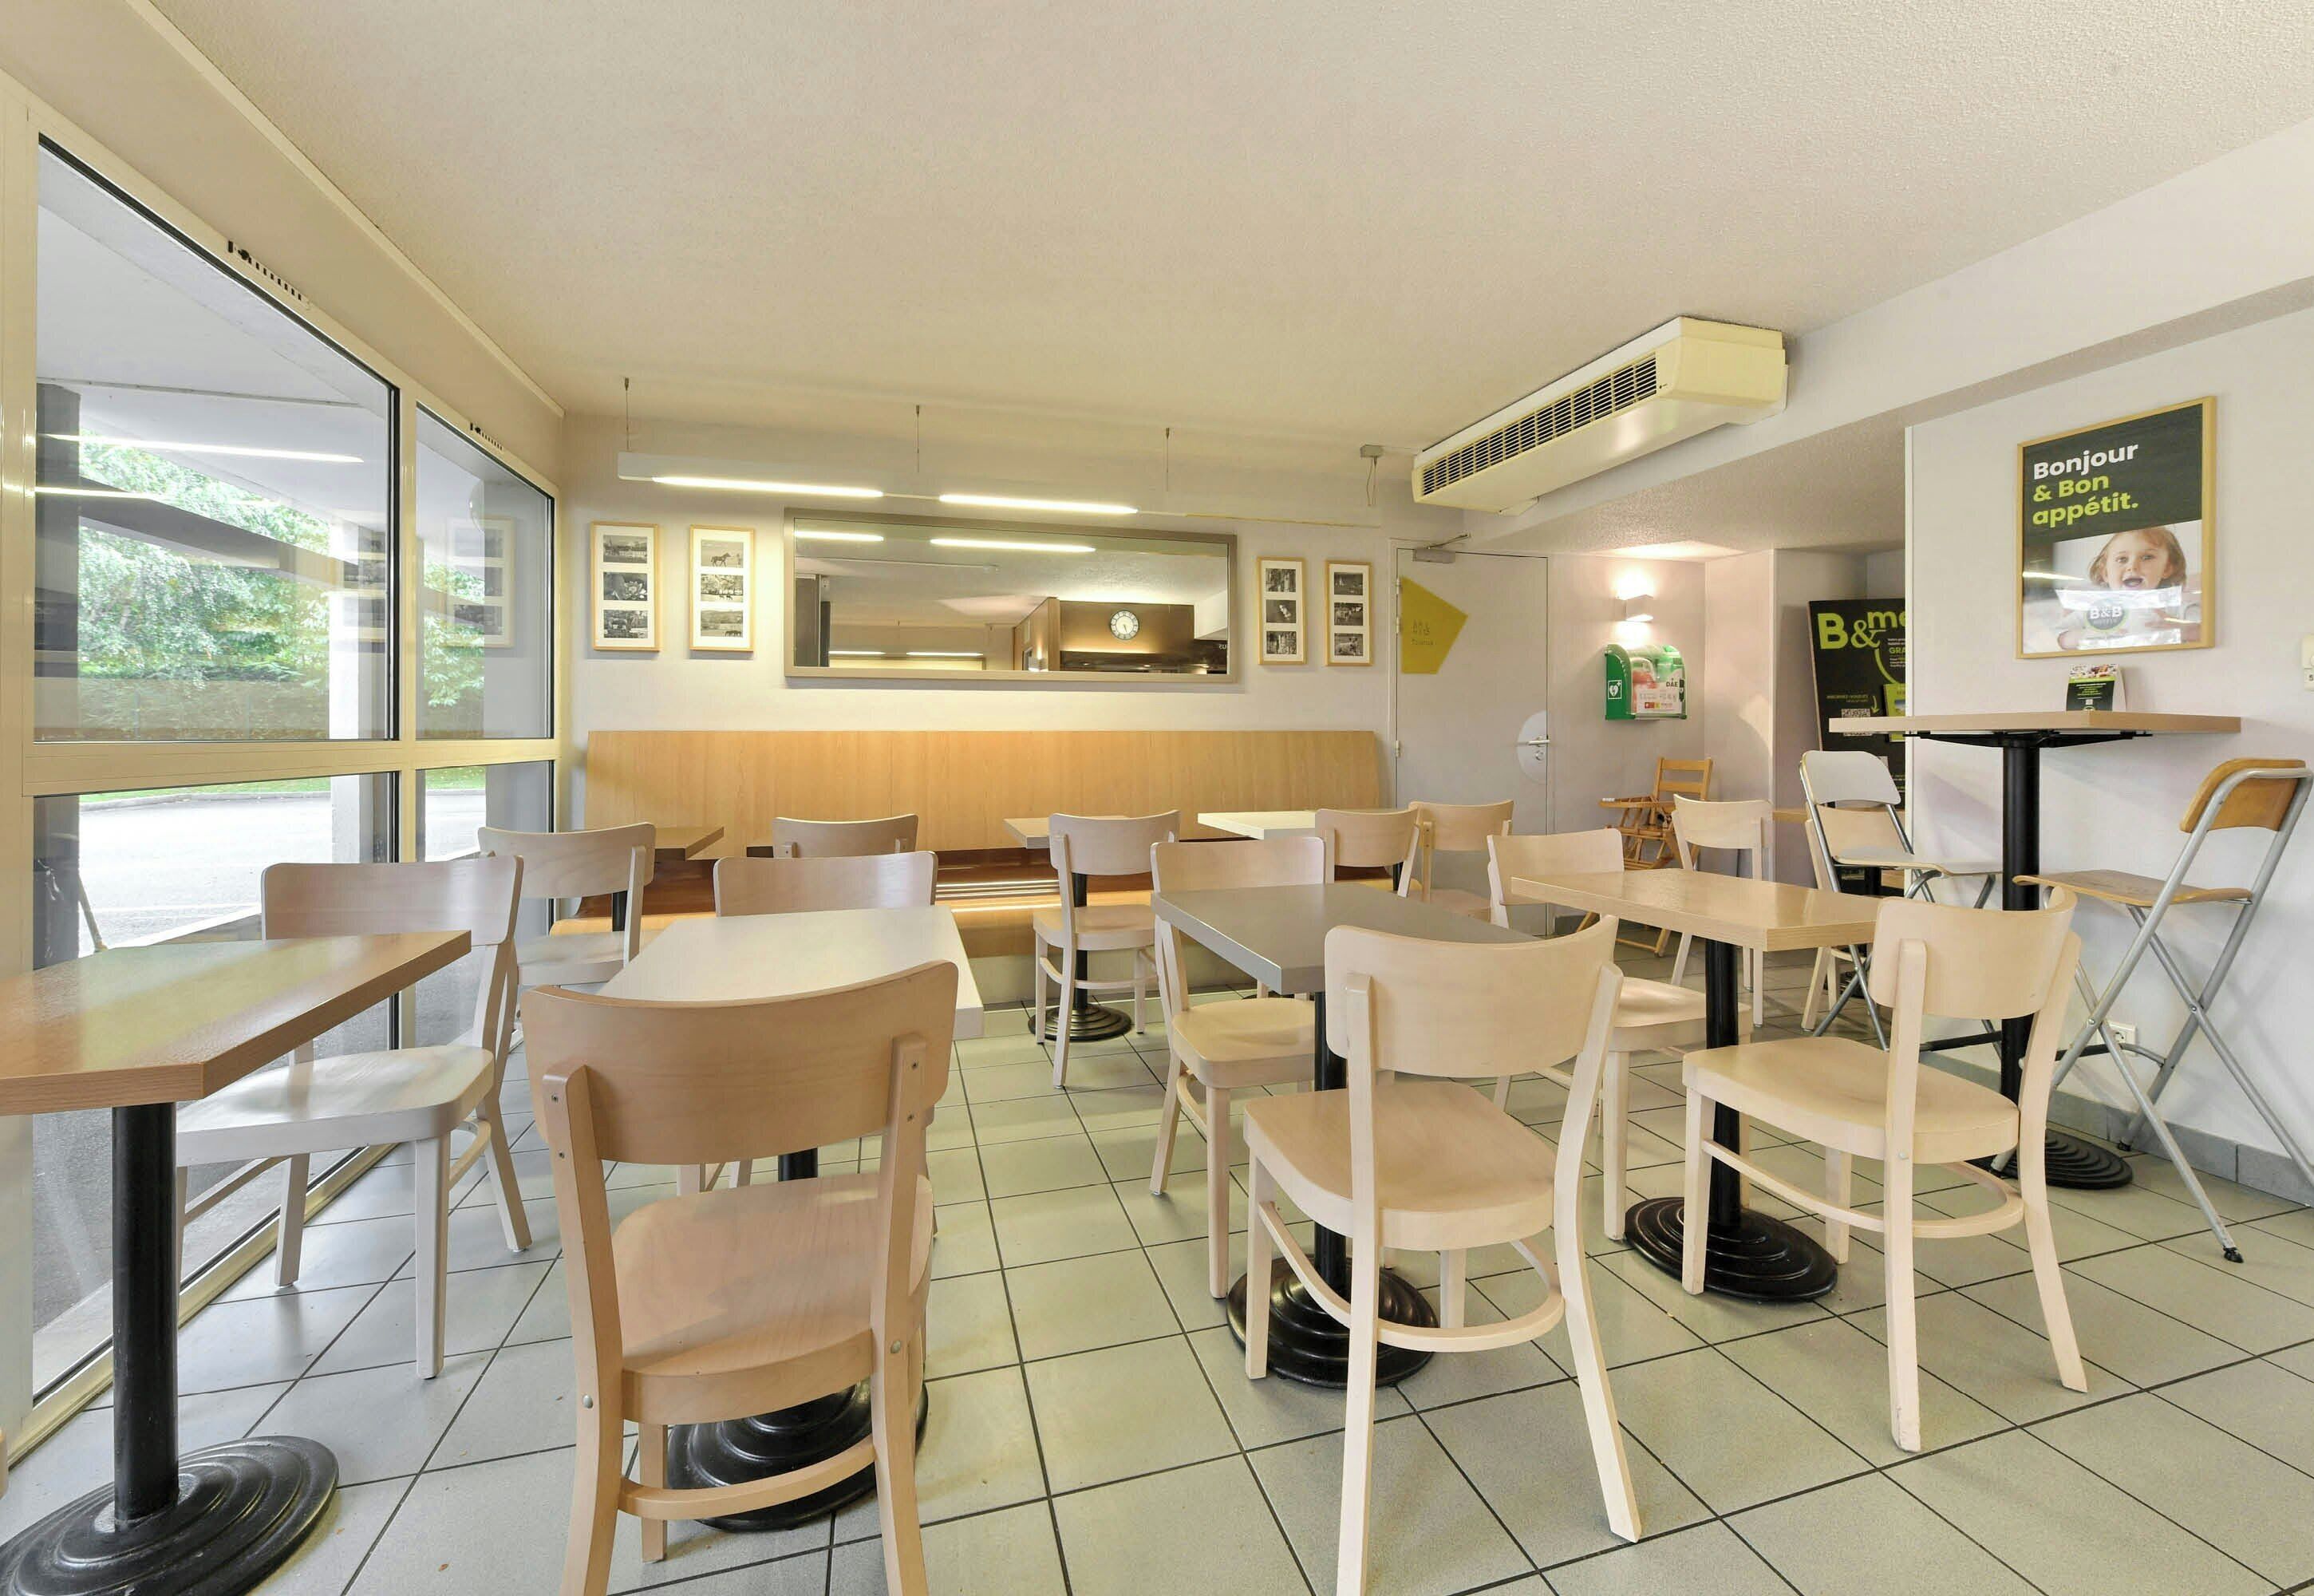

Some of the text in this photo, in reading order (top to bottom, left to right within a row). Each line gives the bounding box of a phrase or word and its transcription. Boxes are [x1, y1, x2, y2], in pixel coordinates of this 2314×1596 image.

[2033, 444, 2138, 480] Bonjour
[2033, 476, 2109, 502] & Bon
[2032, 492, 2138, 527] appétit.
[2090, 606, 2122, 619] B&B
